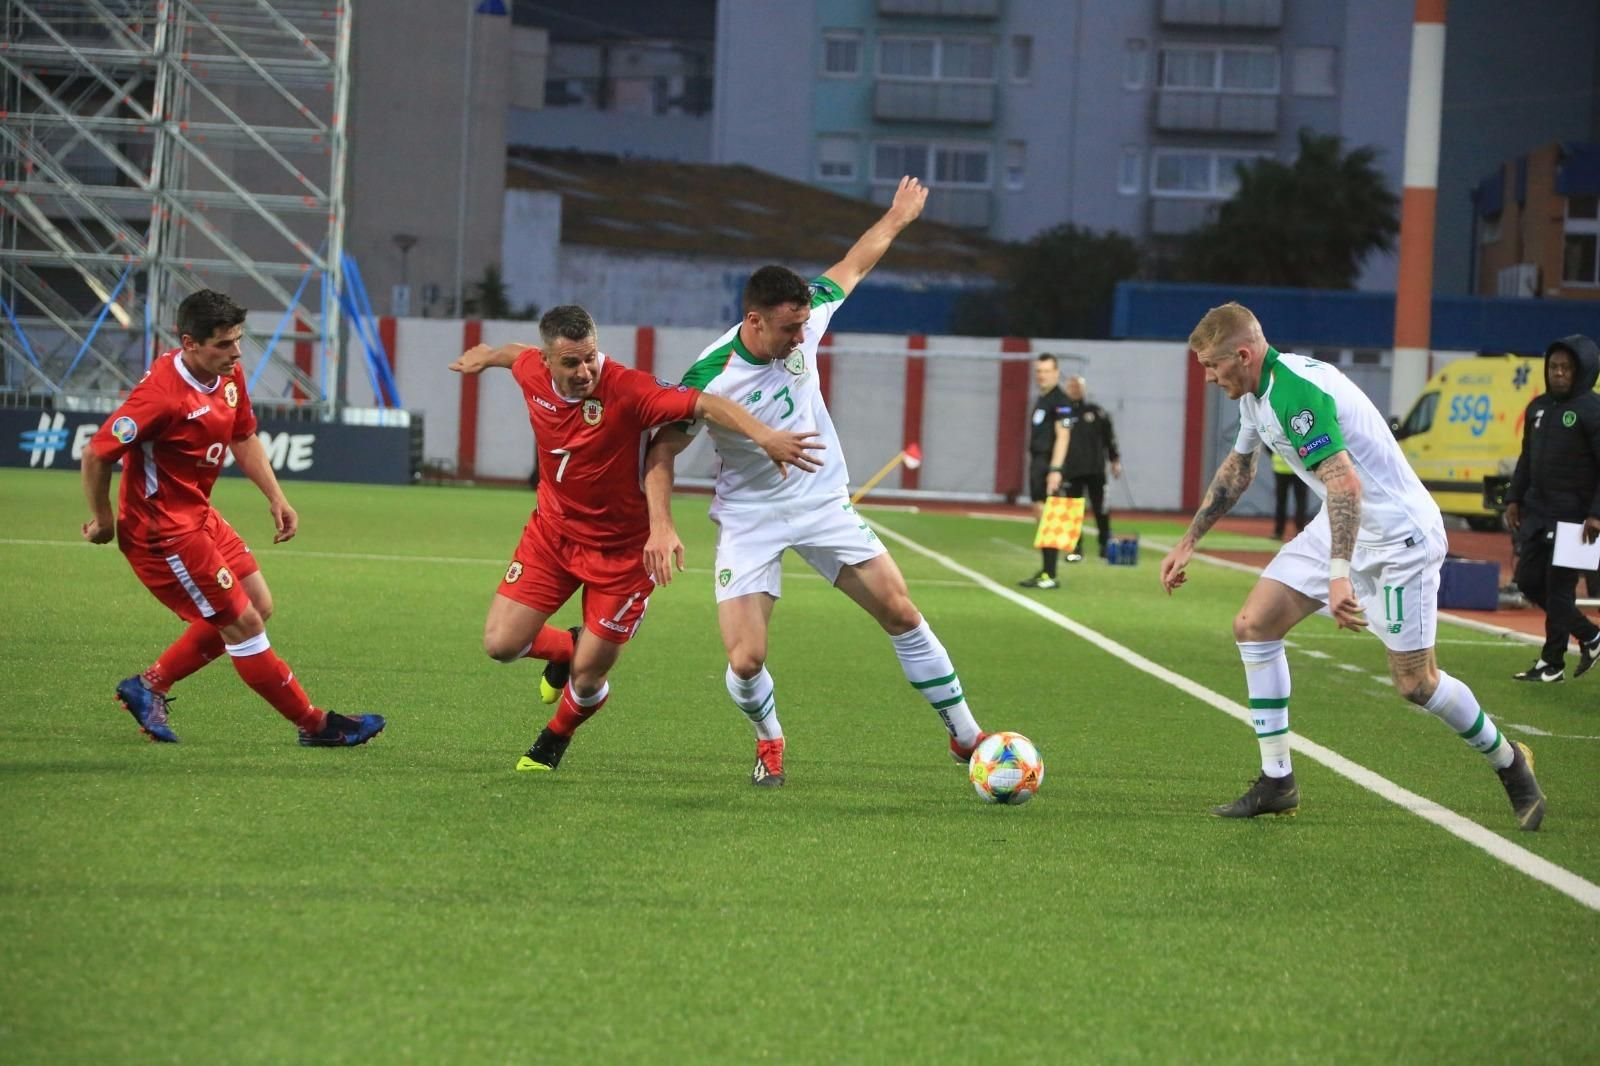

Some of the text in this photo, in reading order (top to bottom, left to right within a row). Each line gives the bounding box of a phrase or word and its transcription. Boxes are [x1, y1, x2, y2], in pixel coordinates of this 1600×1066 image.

[773, 385, 795, 420] 3
[1306, 435, 1330, 451] RESPECT
[549, 447, 571, 484] 7
[1383, 585, 1405, 622] 11
